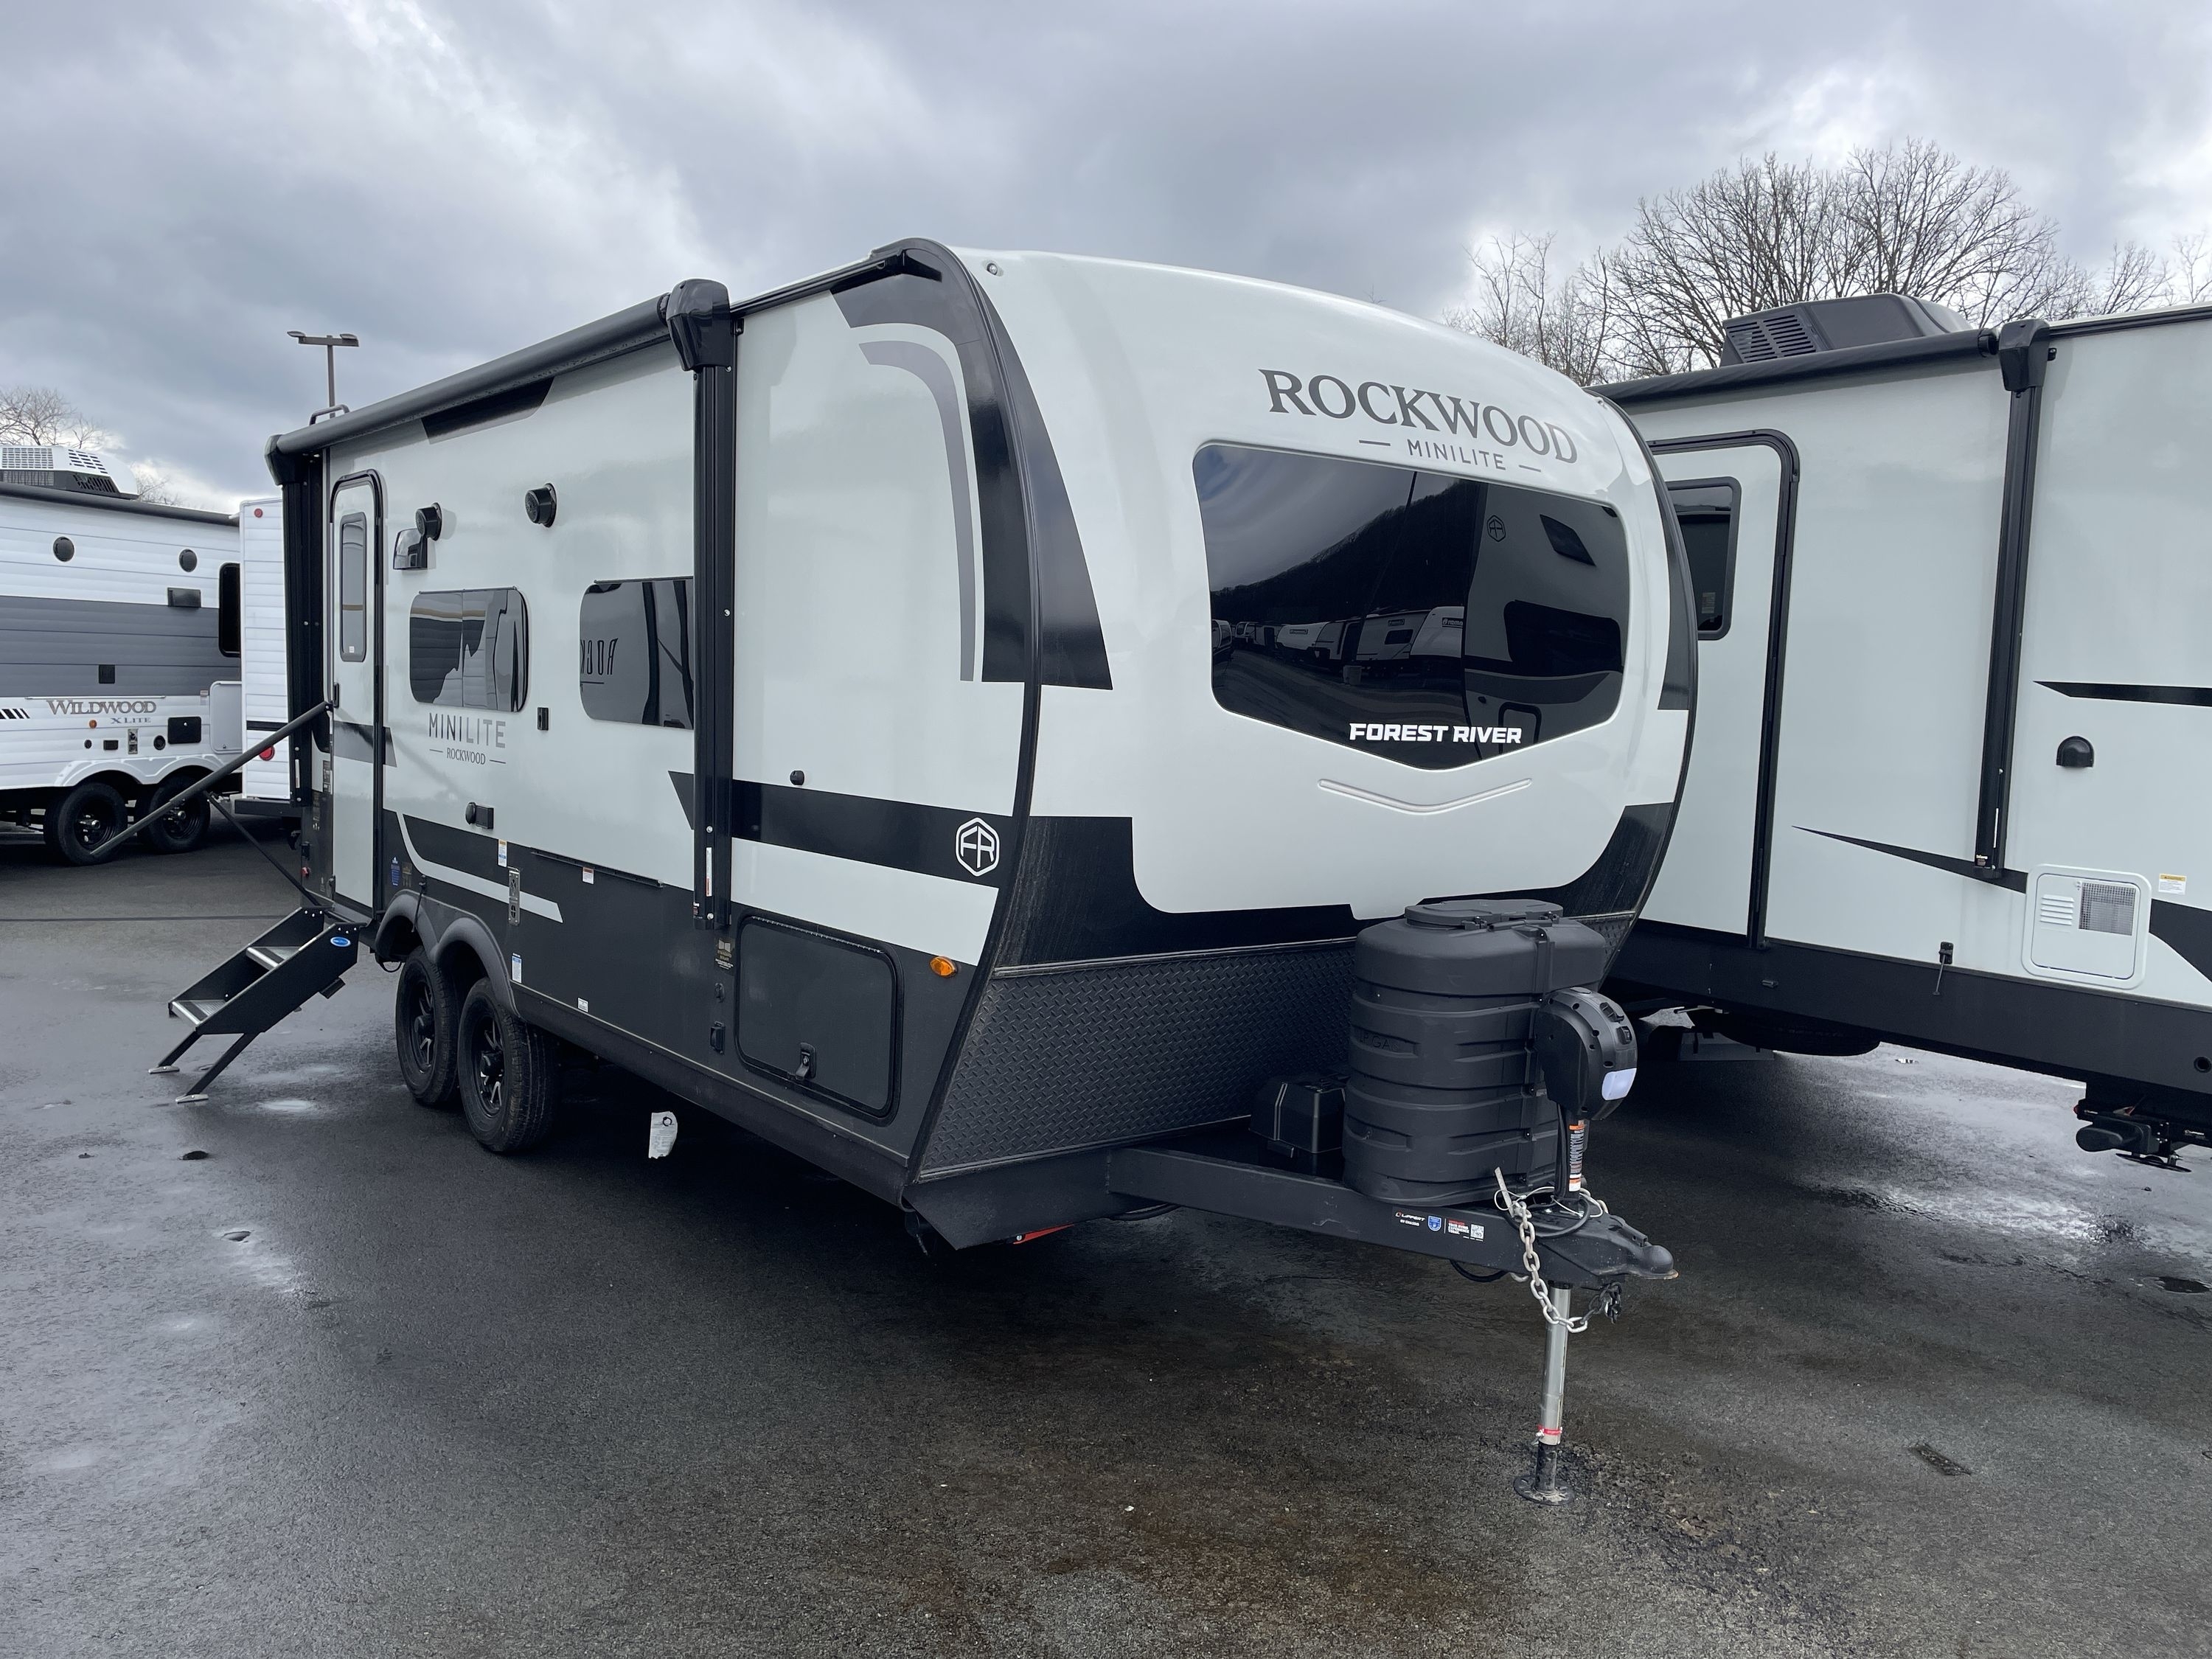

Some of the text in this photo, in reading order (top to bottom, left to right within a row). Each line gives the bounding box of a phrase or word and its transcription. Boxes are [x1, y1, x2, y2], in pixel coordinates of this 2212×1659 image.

[1258, 369, 1578, 464] ROCKWOOD
[1407, 439, 1506, 471] MINILITE
[46, 700, 156, 715] WILDWOOD
[428, 712, 506, 748] MINILITE
[1349, 723, 1522, 744] FOREST RIVER
[446, 747, 486, 765] ROCKWOOD
